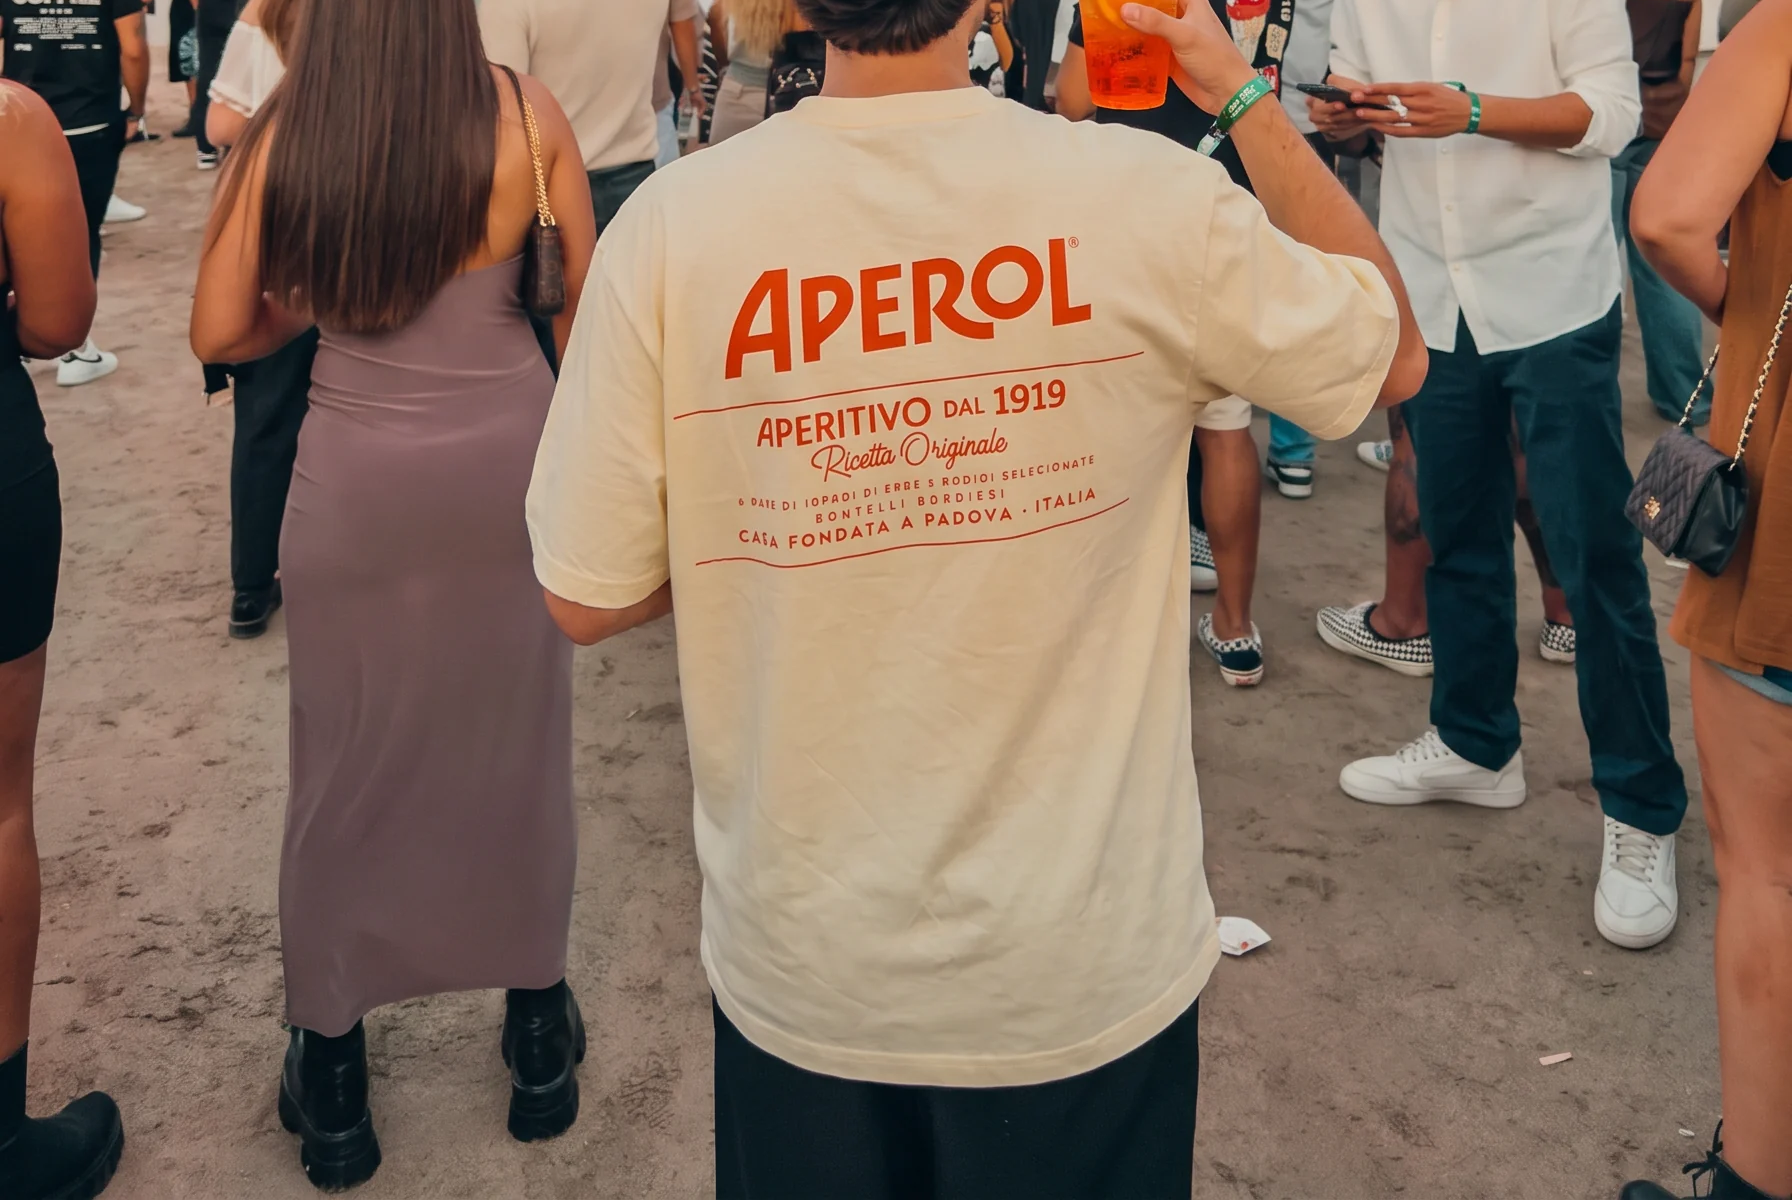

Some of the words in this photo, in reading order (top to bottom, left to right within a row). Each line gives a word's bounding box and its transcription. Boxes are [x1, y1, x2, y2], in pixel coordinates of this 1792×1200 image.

[724, 237, 1093, 381] APEROL
[756, 396, 932, 449] APERITIVO
[943, 396, 986, 420] DAL
[992, 378, 1068, 417] 1919
[810, 443, 897, 482] Ricetta
[899, 427, 1009, 471] Originale
[863, 486, 877, 499] DI
[1002, 454, 1095, 481] SELECIONATE
[788, 520, 890, 550] FONDATA
[900, 515, 914, 531] A
[924, 506, 1013, 528] PADOVA
[1034, 487, 1097, 514] ITALIA
[815, 498, 904, 524] BONTELLI
[917, 488, 1005, 507] BORDIESI
